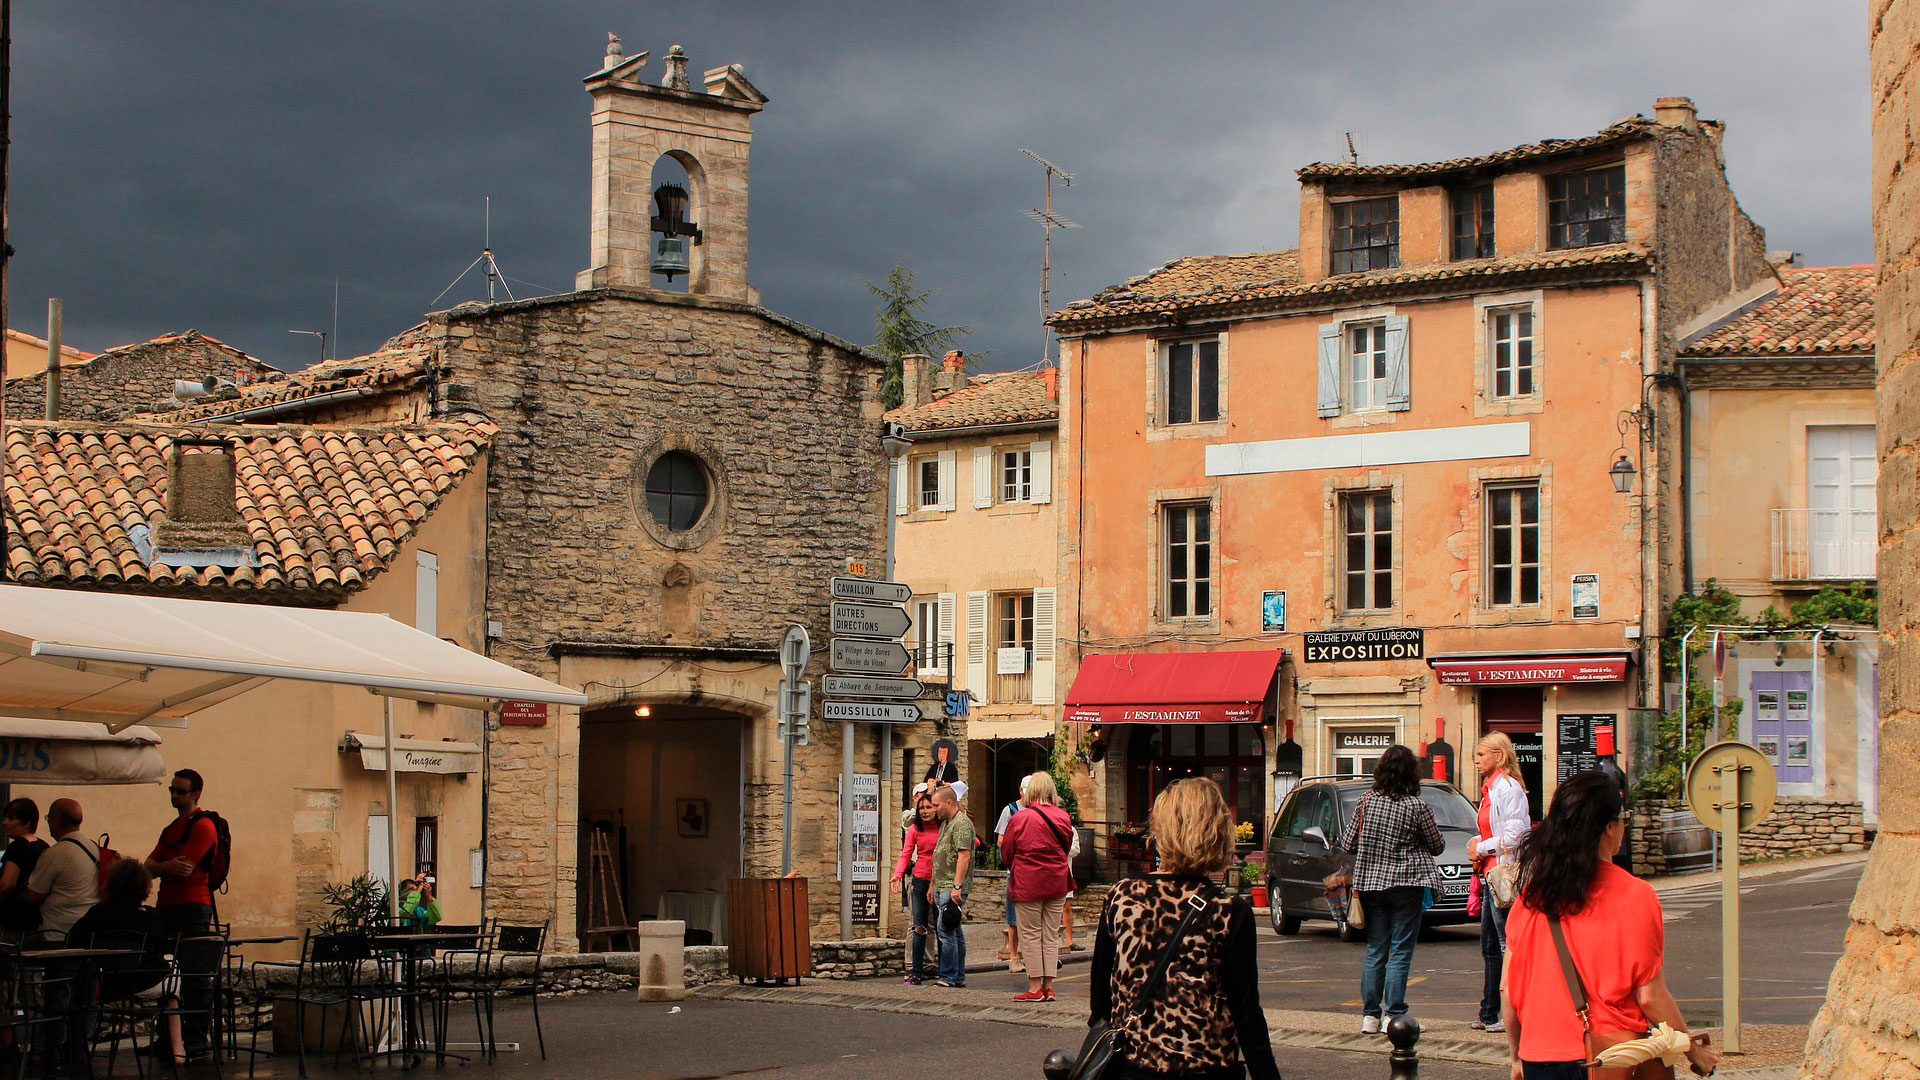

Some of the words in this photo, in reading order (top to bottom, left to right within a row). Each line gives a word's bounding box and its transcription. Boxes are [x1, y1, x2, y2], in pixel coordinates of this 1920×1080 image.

[850, 563, 864, 573] D15
[837, 583, 875, 595] CAVAILLON
[896, 588, 904, 598] 17
[836, 607, 865, 618] AUTRES
[836, 619, 879, 631] DIRECTIONS
[1307, 634, 1340, 643] GALERIE
[1341, 632, 1365, 643] D'ART
[1367, 632, 1380, 642] DU
[845, 646, 862, 656] Village
[864, 647, 873, 655] des
[875, 648, 890, 656] Bories
[1308, 644, 1418, 660] EXPOSITION
[845, 657, 861, 666] Musée
[871, 659, 887, 667] Vitrail
[1478, 668, 1565, 681] L'ESTAMINET
[839, 682, 861, 691] Abbaye
[863, 683, 872, 691] de
[826, 705, 890, 717] ROUSSILLON
[902, 708, 914, 718] 12
[1123, 711, 1201, 720] L'ESTAMINET
[1344, 735, 1390, 746] GALERIE
[405, 752, 443, 768] Imagine
[1445, 885, 1461, 894] 266
